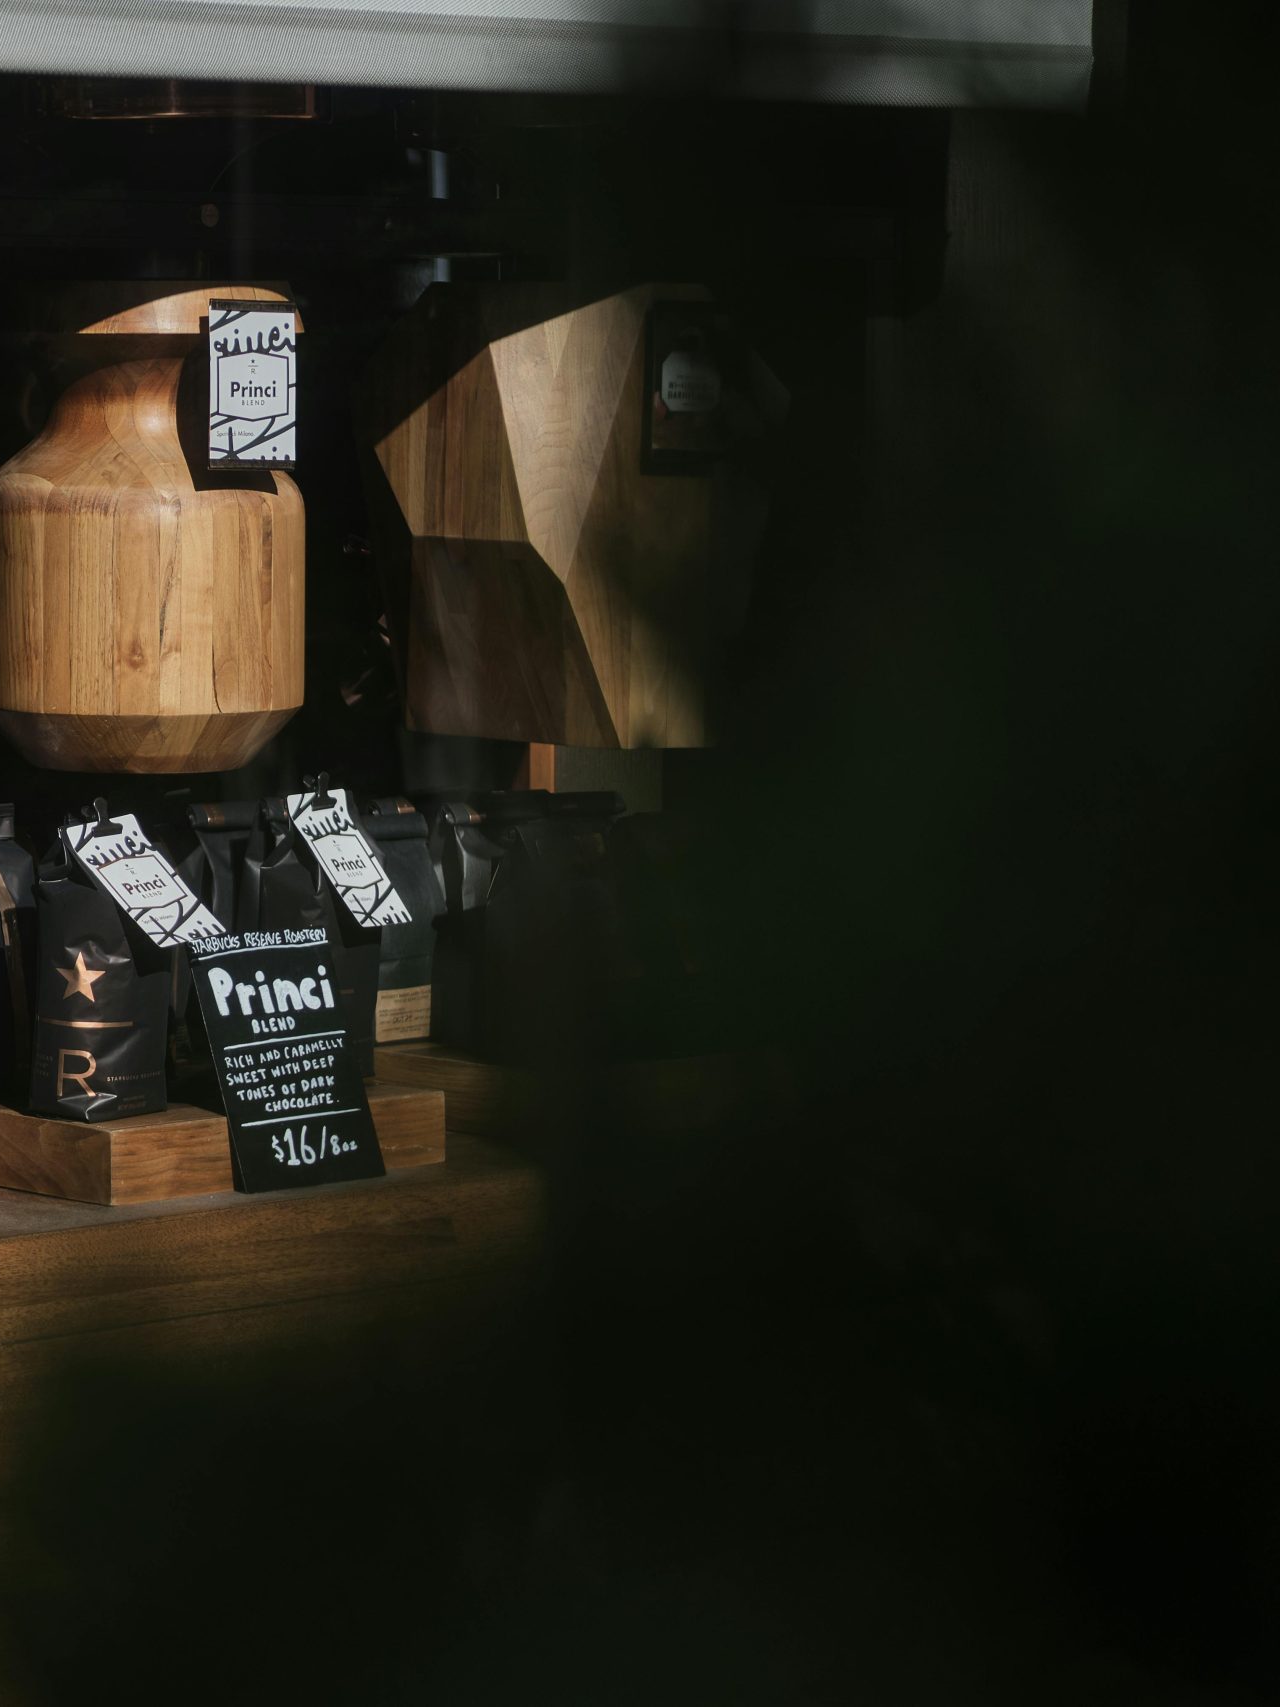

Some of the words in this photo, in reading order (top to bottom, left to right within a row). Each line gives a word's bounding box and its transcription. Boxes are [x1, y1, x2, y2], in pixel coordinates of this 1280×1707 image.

[230, 380, 276, 398] Princi
[331, 854, 366, 872] Princi
[122, 874, 167, 895] Princi
[244, 929, 282, 947] RESERVE
[284, 928, 326, 943] ROASTERY
[207, 964, 335, 1017] Princi
[251, 1016, 296, 1034] BLEND
[224, 1054, 254, 1069] RICH
[259, 1050, 281, 1064] AND
[284, 1038, 344, 1059] CARAMELLY
[56, 1048, 97, 1097] R
[226, 1068, 267, 1087] SWEET
[271, 1062, 300, 1078] WITH
[302, 1055, 335, 1072] DEEP
[237, 1084, 275, 1101] TONES
[281, 1081, 296, 1095] OF
[300, 1075, 335, 1092] DARK
